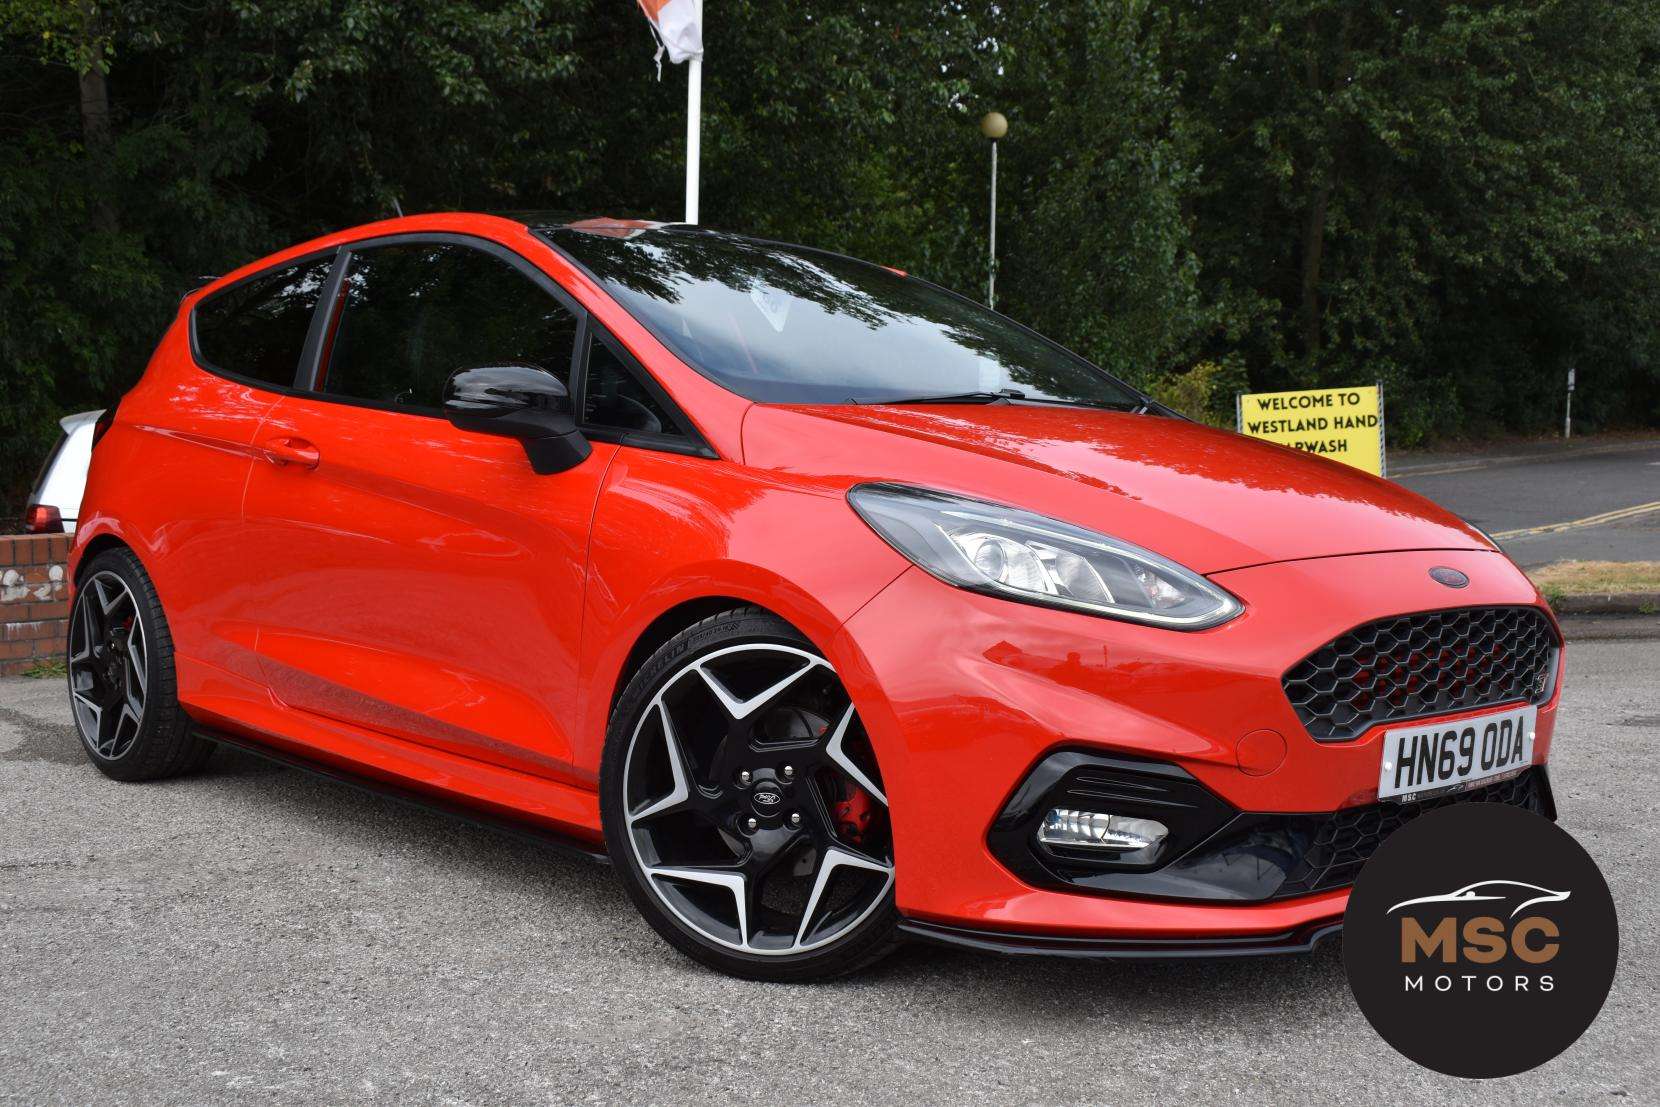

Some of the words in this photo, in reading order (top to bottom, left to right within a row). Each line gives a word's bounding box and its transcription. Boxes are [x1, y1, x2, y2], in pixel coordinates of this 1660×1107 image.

[1258, 394, 1333, 411] WELCOME
[1338, 392, 1360, 406] TO
[1248, 418, 1328, 434] WESTLAND
[1334, 415, 1378, 430] HAND
[1394, 727, 1476, 789] HN69
[1480, 715, 1524, 772] ODA
